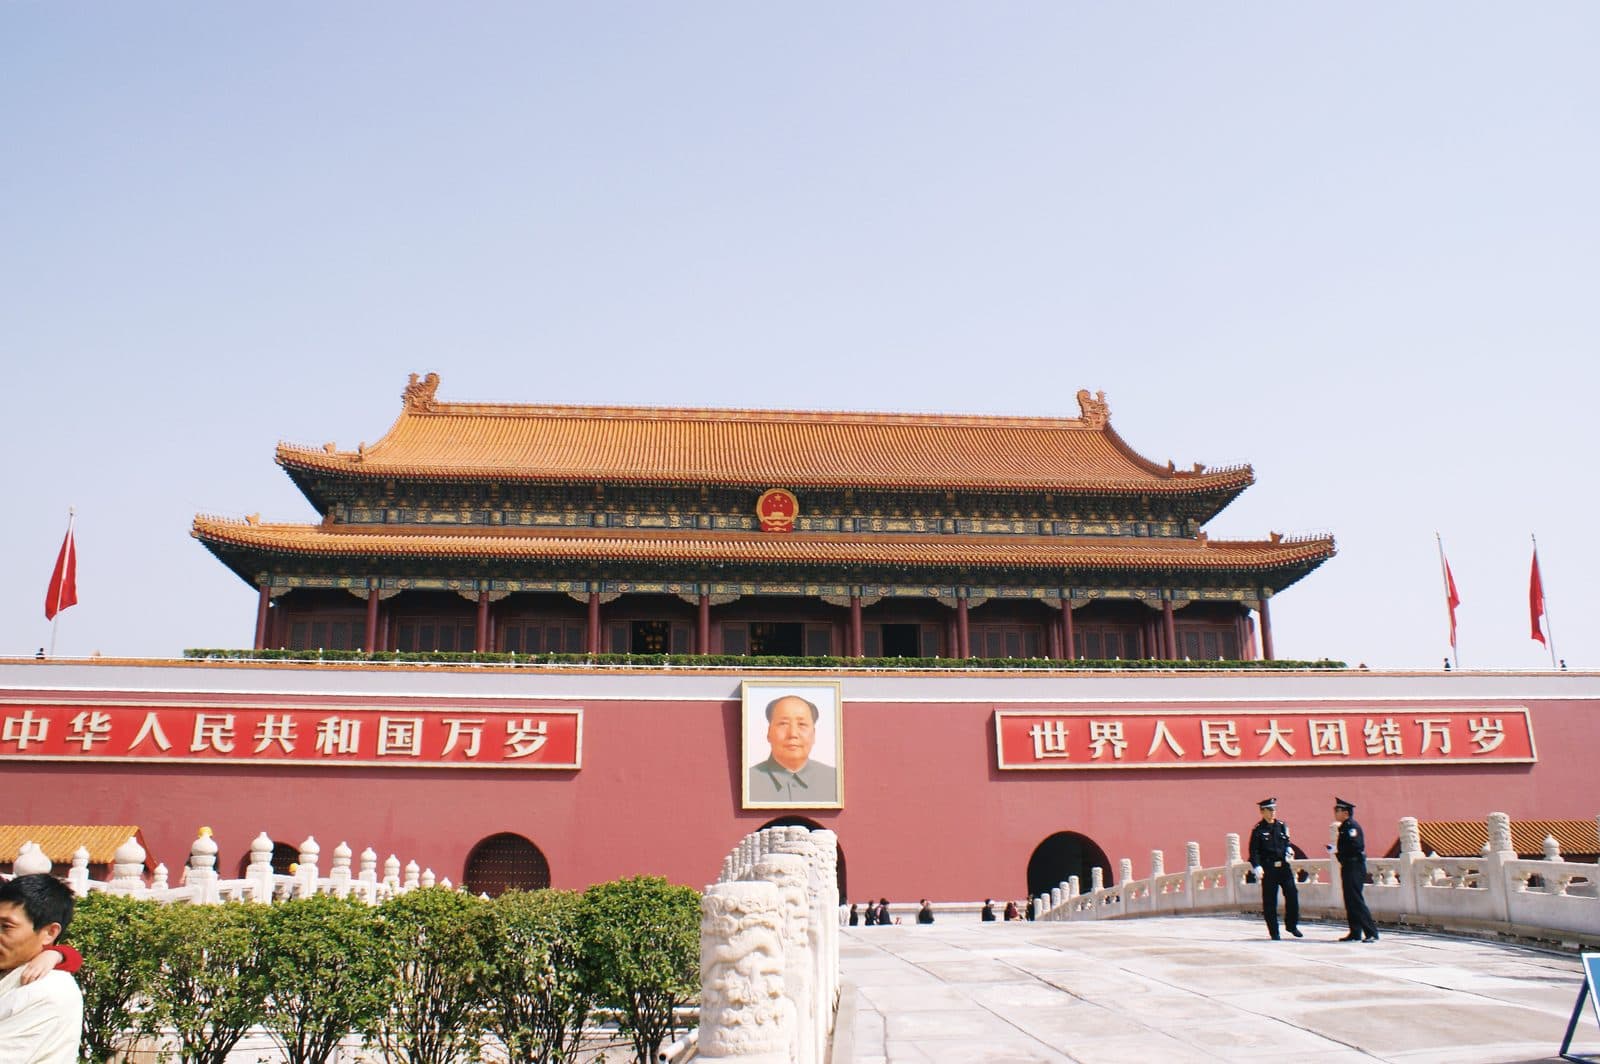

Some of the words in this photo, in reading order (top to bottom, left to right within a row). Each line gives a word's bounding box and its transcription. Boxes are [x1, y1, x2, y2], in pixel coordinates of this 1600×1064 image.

[2, 710, 549, 758] 中华人民共和国万岁
[1028, 718, 1506, 759] 世界人民大团结万岁
